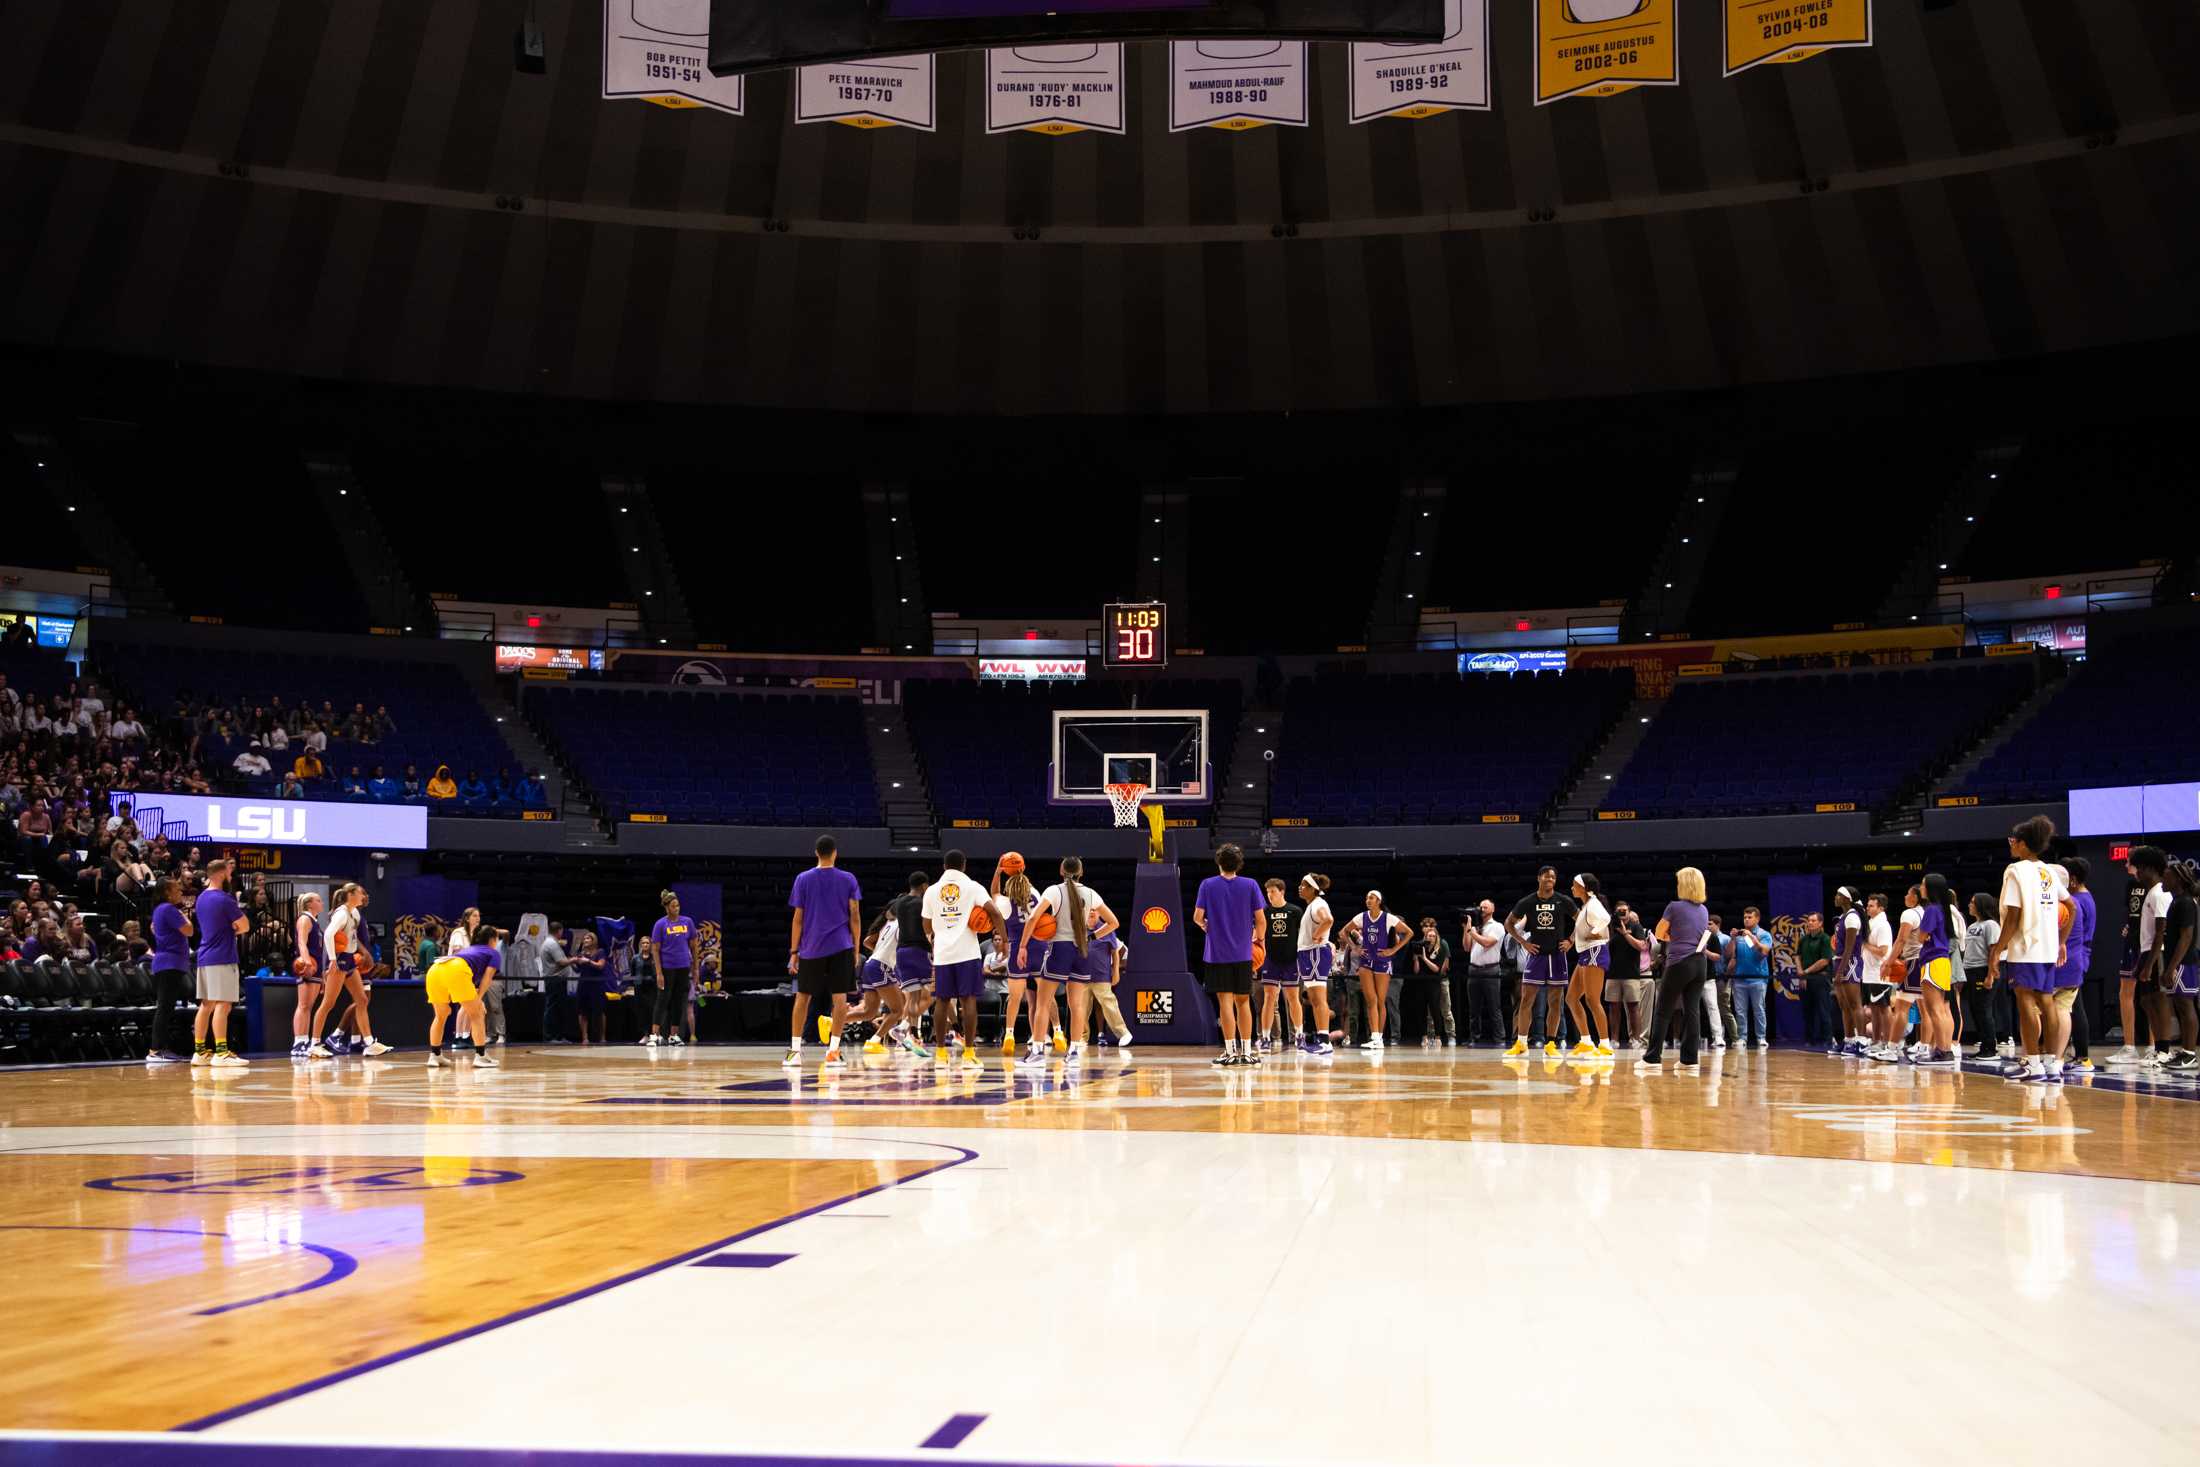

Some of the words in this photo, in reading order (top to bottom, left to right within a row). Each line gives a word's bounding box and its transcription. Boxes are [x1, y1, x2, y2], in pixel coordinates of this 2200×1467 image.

[1758, 9, 1790, 24] SYLVIA
[1794, 0, 1832, 15] FOWLES
[1763, 13, 1827, 39] 2004-08
[1558, 44, 1600, 59] SEIMONE
[1604, 36, 1654, 52] AUGUSTUS
[647, 52, 665, 65] BOB
[669, 54, 701, 69] PETTIT
[1575, 51, 1637, 72] 2002-06
[646, 64, 701, 84] 1951-54
[1376, 66, 1426, 79] SHAQUILLE
[1430, 61, 1462, 73] O'NEAL
[829, 74, 852, 85] PETE
[855, 76, 903, 88] MARAVICH
[997, 83, 1034, 92] DURAND
[1072, 83, 1113, 92] MACKLIN
[1189, 80, 1233, 90] MAHMOUD
[1391, 75, 1448, 92] 1989-92
[838, 86, 893, 102] 1967-70
[1030, 95, 1080, 107] 1976-81
[1210, 90, 1267, 105] 1988-90
[1117, 611, 1159, 627] 11:03
[1118, 629, 1153, 659] 30
[208, 804, 306, 841] LSU
[533, 812, 551, 820] 107
[1499, 814, 1517, 822] 109
[2114, 847, 2128, 859] EXIT
[2131, 888, 2145, 896] LSU
[666, 925, 688, 935] LSU
[1136, 991, 1173, 1013] H&E
